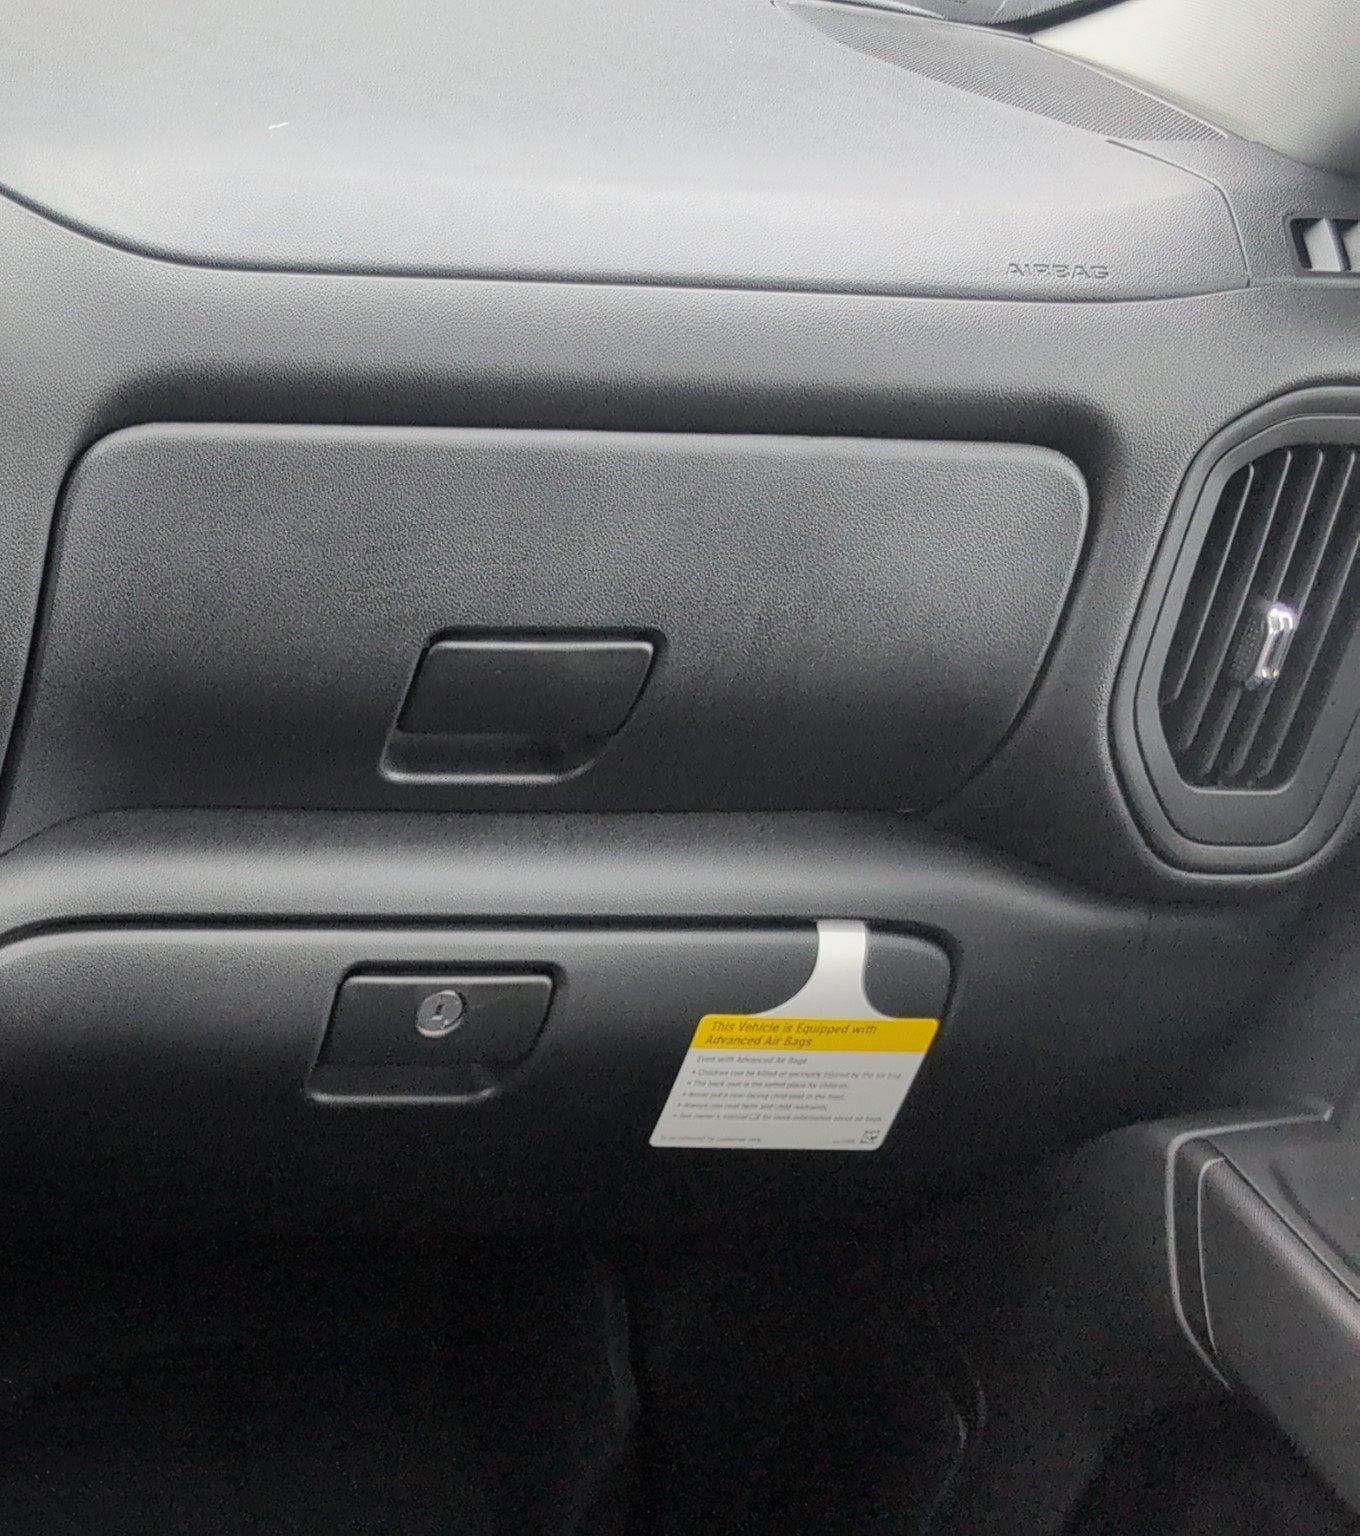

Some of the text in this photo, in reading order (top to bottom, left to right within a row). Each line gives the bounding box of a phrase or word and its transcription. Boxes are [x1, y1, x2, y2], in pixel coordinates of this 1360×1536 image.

[1006, 262, 1109, 279] AIRBAG
[711, 1021, 877, 1036] This Vehicle is Equipped with
[705, 1034, 812, 1048] Advanced Air Bags
